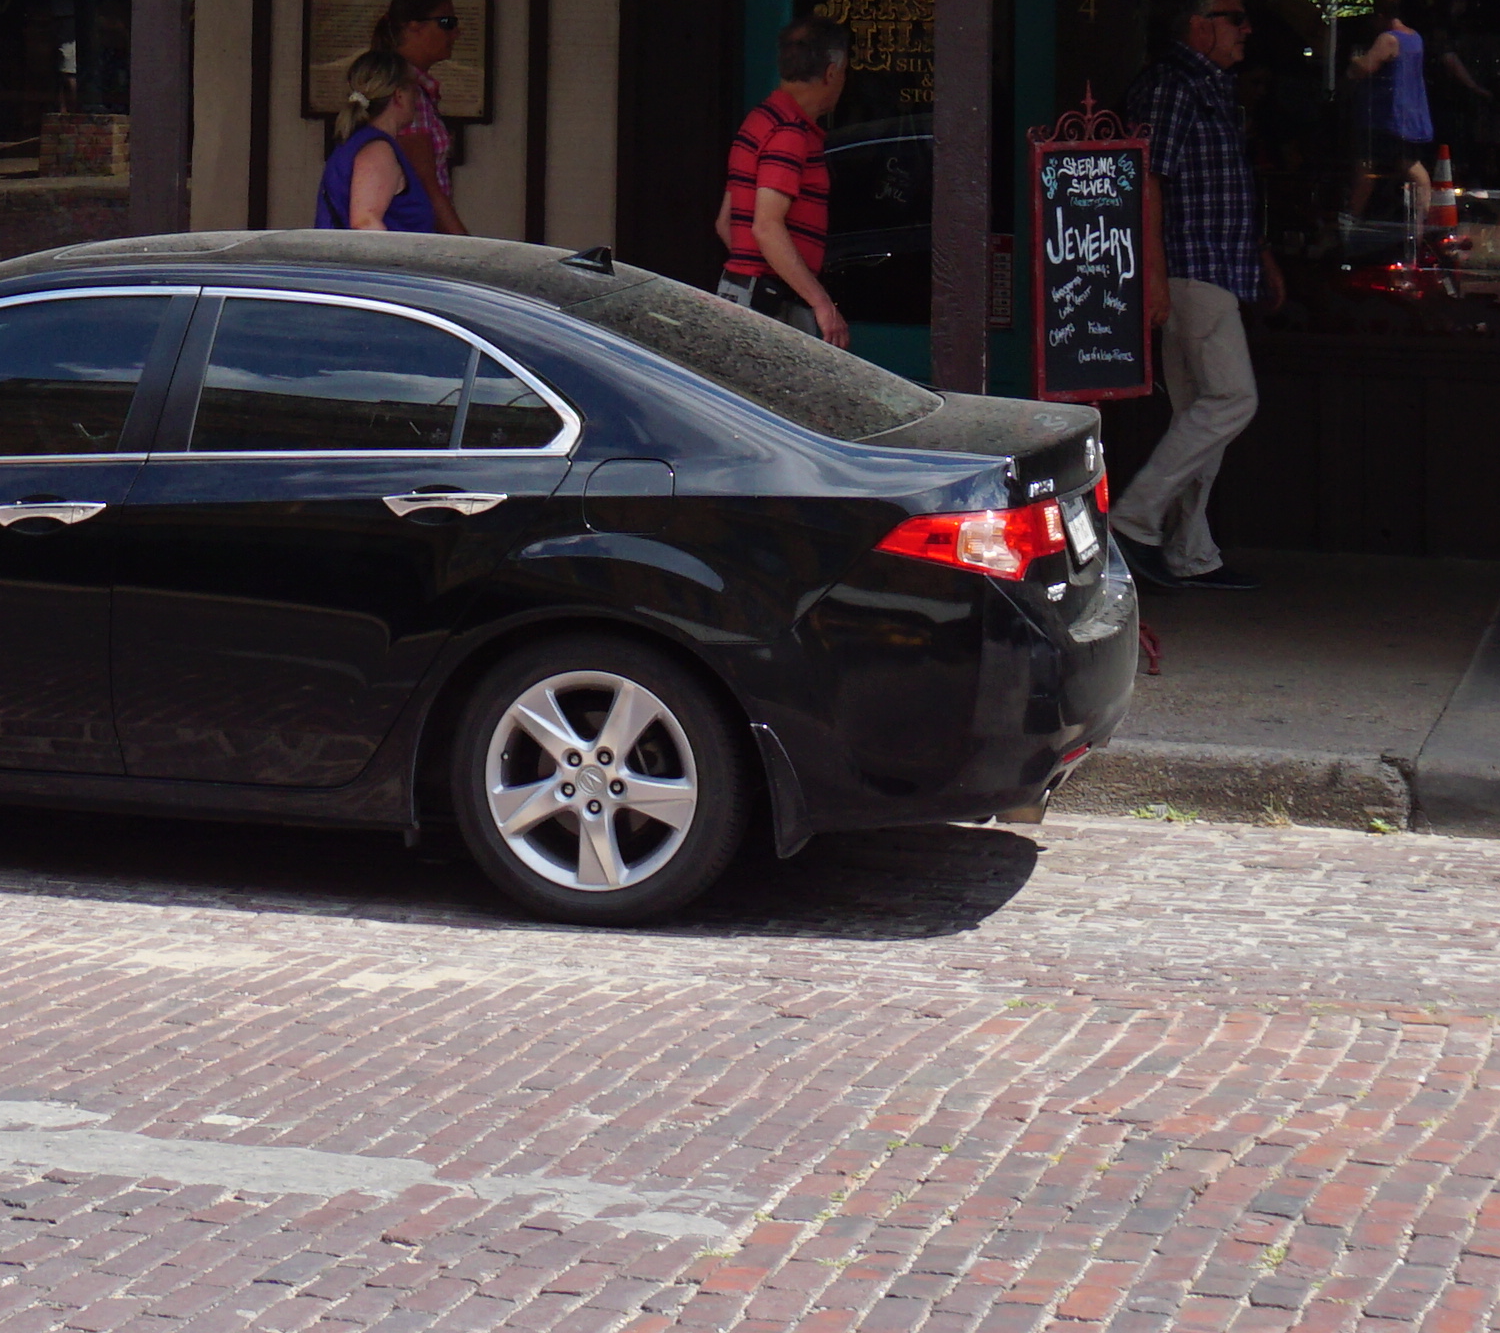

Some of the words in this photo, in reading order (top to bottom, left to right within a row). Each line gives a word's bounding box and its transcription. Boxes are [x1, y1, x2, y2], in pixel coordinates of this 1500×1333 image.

[900, 89, 934, 103] STO
[1057, 156, 1116, 179] STERLING
[1066, 177, 1117, 198] SILVER
[1046, 206, 1135, 286] JEWELRY
